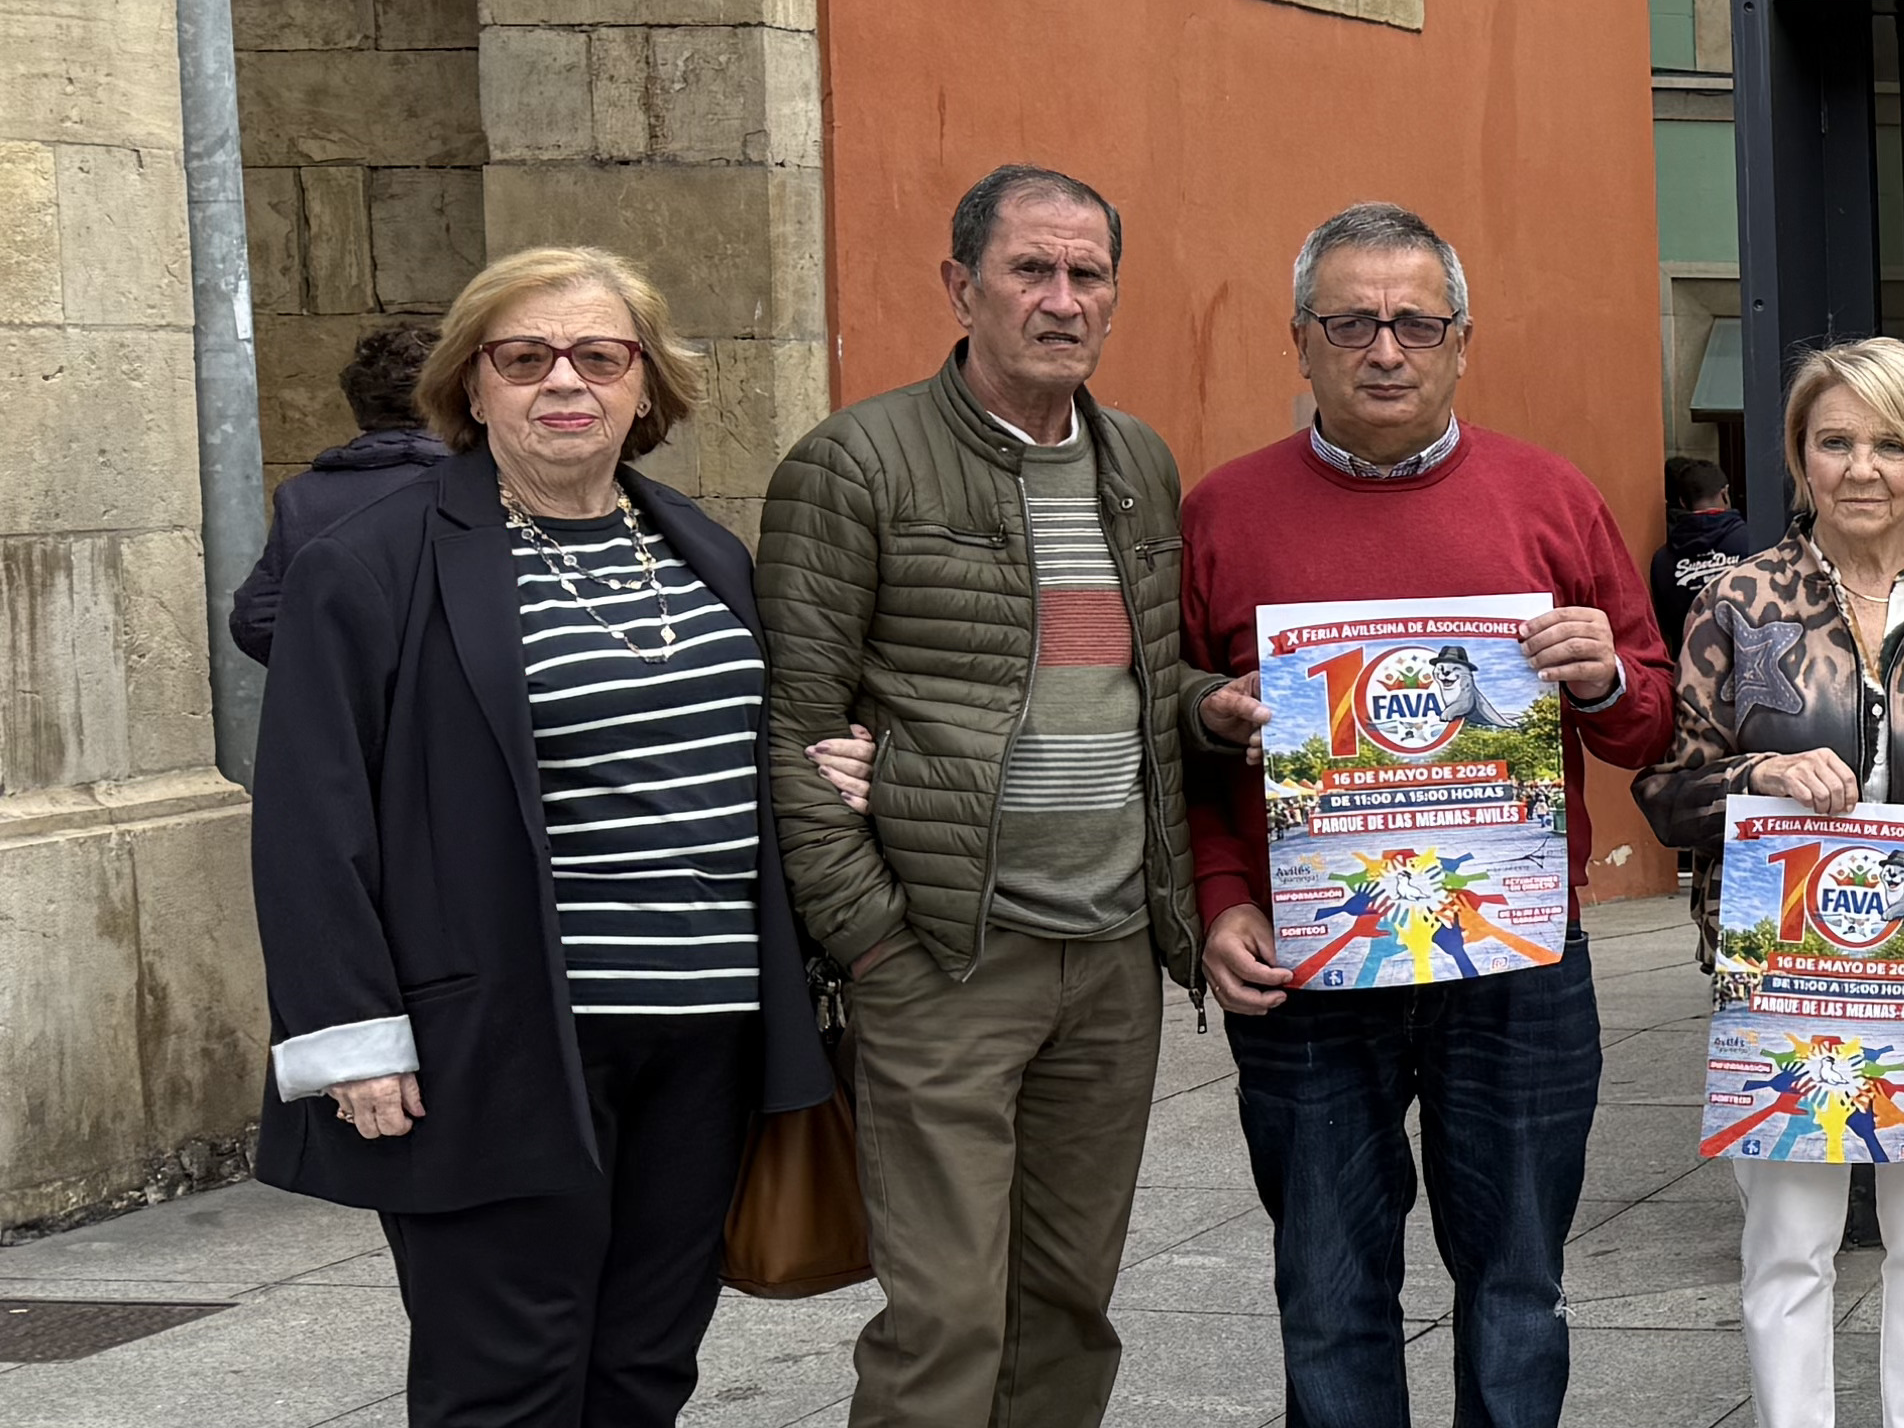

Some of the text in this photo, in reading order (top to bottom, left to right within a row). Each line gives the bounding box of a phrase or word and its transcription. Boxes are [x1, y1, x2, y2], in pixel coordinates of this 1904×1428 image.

[1286, 630, 1300, 646] X
[1371, 691, 1442, 721] FAVA
[1821, 887, 1884, 915] FAVA
